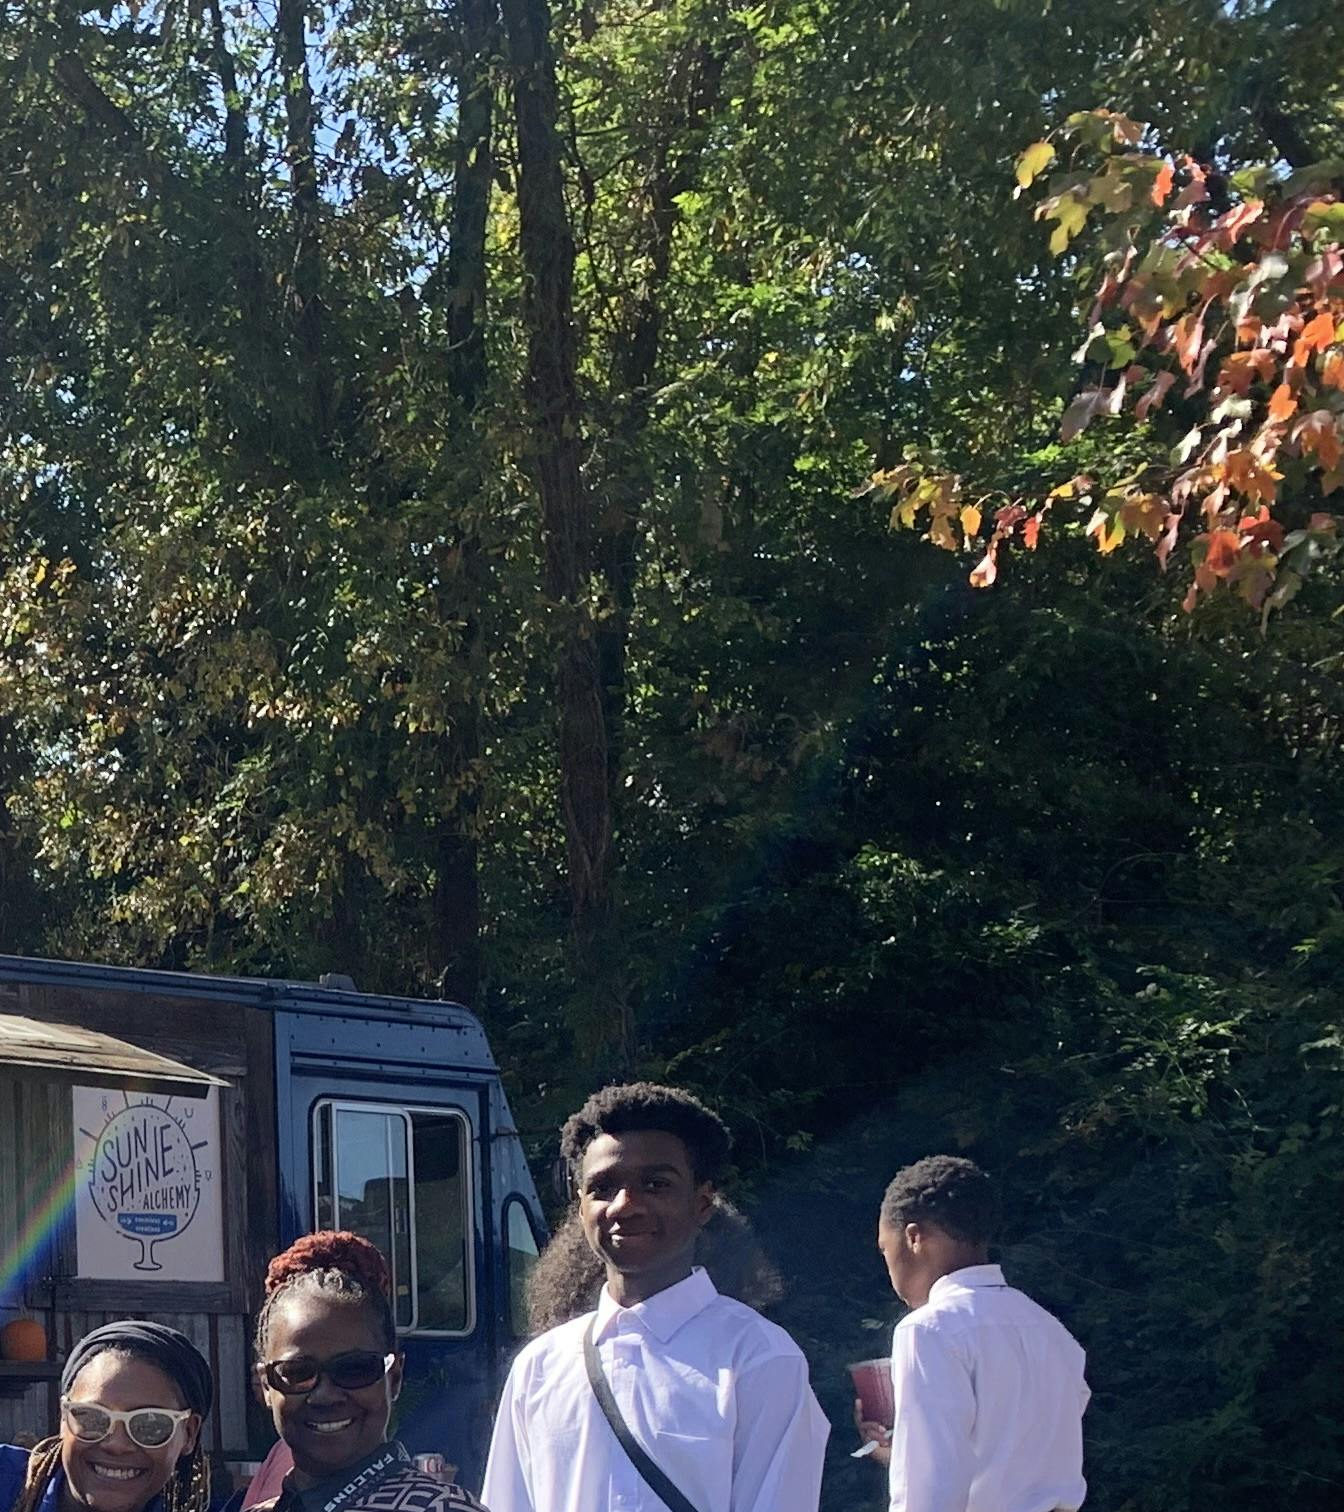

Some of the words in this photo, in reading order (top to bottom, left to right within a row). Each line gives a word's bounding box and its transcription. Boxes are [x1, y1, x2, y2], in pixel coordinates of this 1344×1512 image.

[101, 1117, 147, 1183] SUN
[142, 1183, 192, 1211] ALCHEMY
[323, 1452, 395, 1512] FALCONS
